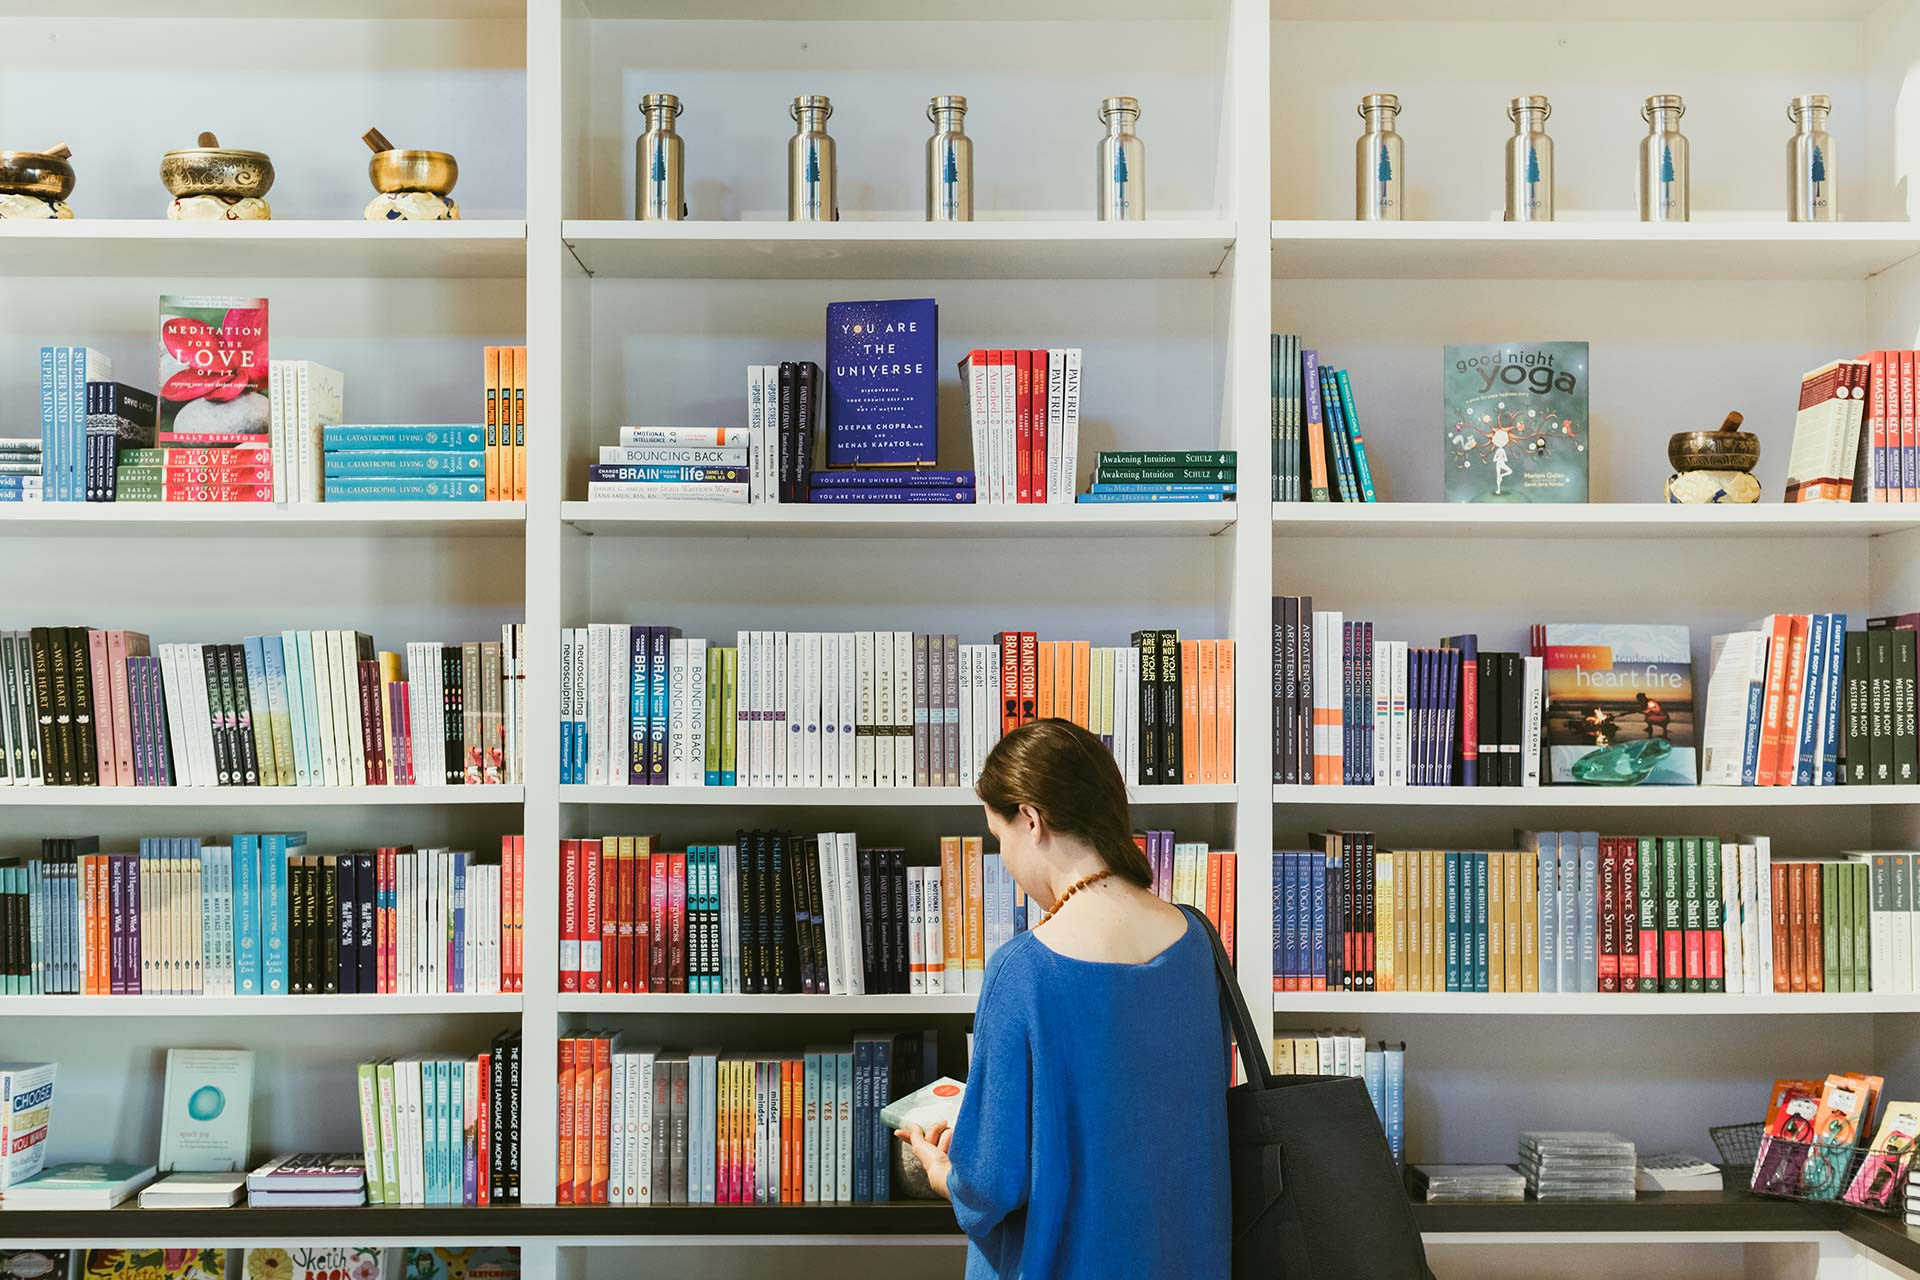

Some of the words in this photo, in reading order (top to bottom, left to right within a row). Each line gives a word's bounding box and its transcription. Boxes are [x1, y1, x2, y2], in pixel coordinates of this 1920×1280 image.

[168, 326, 262, 336] MEDITATION
[842, 324, 874, 334] YOU
[886, 322, 917, 333] ARE
[175, 350, 255, 368] LOVE
[863, 344, 895, 354] THE
[1456, 350, 1502, 373] good
[1508, 351, 1555, 367] night
[42, 352, 52, 389] SUPER
[837, 364, 923, 376] UNIVERSE
[1052, 369, 1061, 393] PAIN
[1476, 365, 1577, 394] yoga
[170, 381, 191, 389] enjoying
[1889, 378, 1897, 416] MASTER
[43, 391, 53, 422] MIND
[124, 396, 137, 408] DAVID
[1051, 398, 1061, 422] FREE
[188, 455, 230, 464] LOVE
[627, 451, 690, 462] BOUNCING
[694, 451, 724, 462] BACK
[1103, 455, 1142, 465] Awakening
[1144, 455, 1176, 463] Intuition
[1186, 454, 1212, 463] SCHULZ
[619, 468, 659, 480] BRAIN
[680, 468, 704, 481] life
[1101, 470, 1140, 480] Awakening
[1142, 470, 1174, 479] Intuition
[1184, 469, 1210, 478] SCHULZ
[1162, 639, 1175, 647] ARE
[1163, 647, 1175, 655] NOT
[36, 649, 45, 672] WISE
[206, 652, 215, 674] TRUE
[960, 651, 968, 688] mindsight
[1022, 635, 1034, 698] BRAINSTORM
[1772, 643, 1784, 691] SUBTLE
[1832, 654, 1840, 674] BODY
[575, 643, 585, 716] neurosculpting
[634, 656, 646, 696] BRAIN
[1576, 664, 1640, 688] heart
[1646, 665, 1682, 688] fire
[38, 675, 49, 708] HEART
[208, 677, 220, 713] REFUGE
[673, 666, 683, 730] BOUNCING
[1830, 675, 1838, 712] PRACTICE
[1768, 695, 1778, 728] BODY
[633, 717, 647, 741] life
[1828, 712, 1836, 744] MANUAL
[673, 734, 683, 762] BACK
[655, 862, 664, 893] Radical
[709, 864, 717, 895] SACRED
[1686, 841, 1695, 898] awakening
[127, 876, 136, 907] Happiness
[566, 854, 574, 933] TRANSFORMATION
[1315, 884, 1324, 912] YOGA
[1566, 860, 1575, 921] ORIGINAL
[1602, 858, 1614, 911] RADIANCE
[653, 895, 664, 942] Forgiveness
[711, 913, 718, 922] JB
[1687, 899, 1699, 928] Shakti
[1314, 914, 1324, 950] SUTRAS
[1566, 925, 1575, 962] LIGHT
[1604, 912, 1615, 953] SUTRAS
[711, 924, 719, 972] GLOSSINGER
[14, 1085, 51, 1110] CHOOSE
[807, 1101, 816, 1121] YES
[16, 1115, 31, 1129] THE
[495, 1131, 502, 1140] OF
[13, 1137, 28, 1151] YOU
[31, 1128, 47, 1143] WANT
[627, 1136, 636, 1179] Originals
[293, 1247, 346, 1270] Sketch
